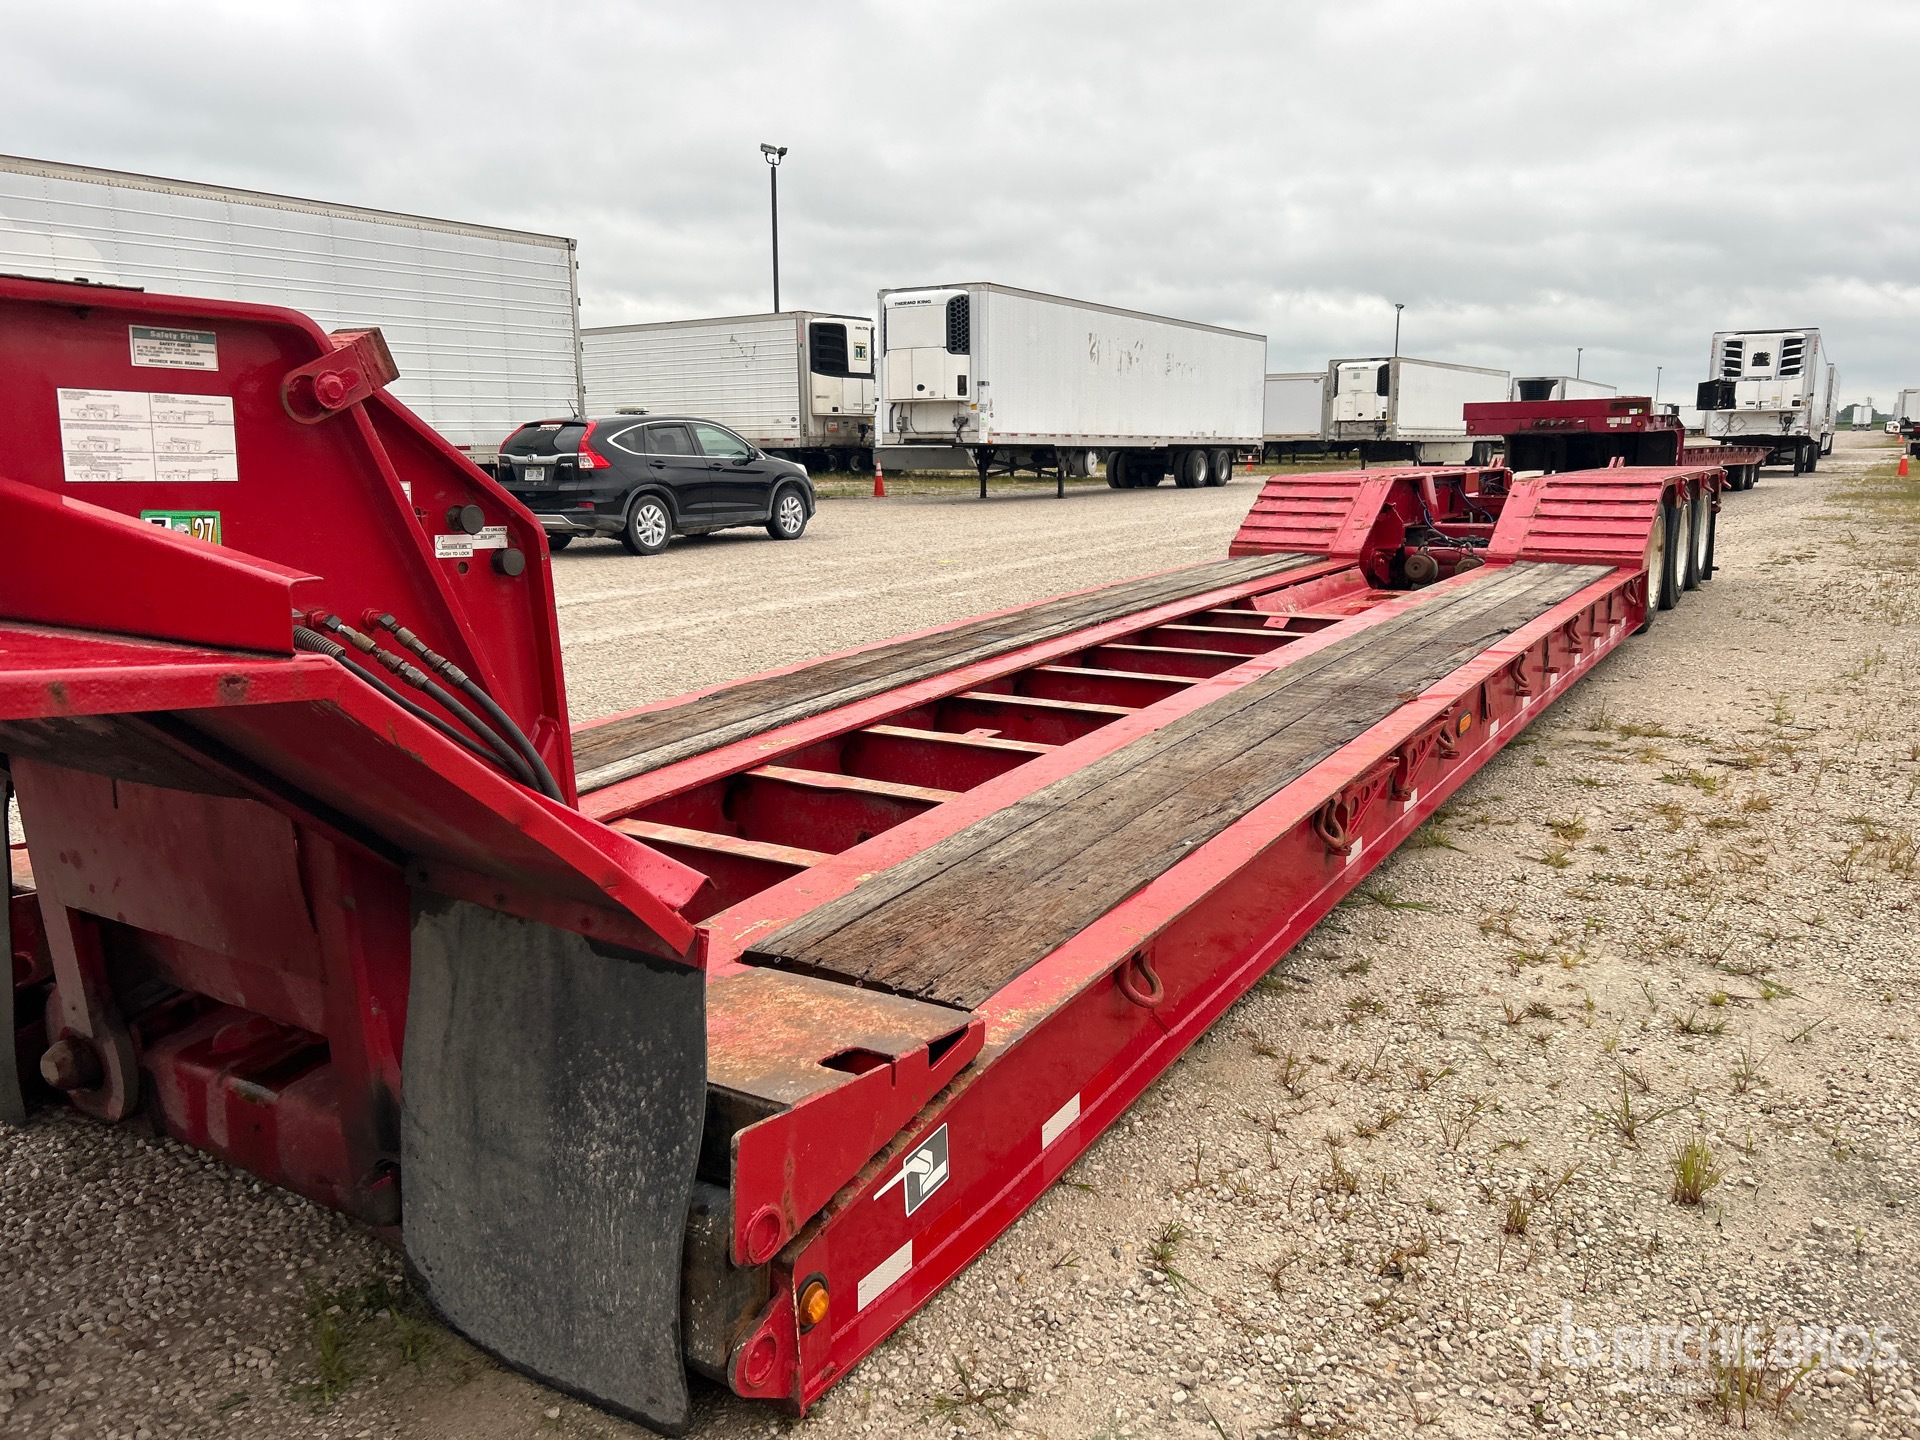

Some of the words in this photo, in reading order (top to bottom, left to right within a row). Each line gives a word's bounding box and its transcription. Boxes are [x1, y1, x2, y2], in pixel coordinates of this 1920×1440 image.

[150, 331, 177, 340] Safety
[181, 333, 199, 341] First
[194, 518, 214, 543] 27
